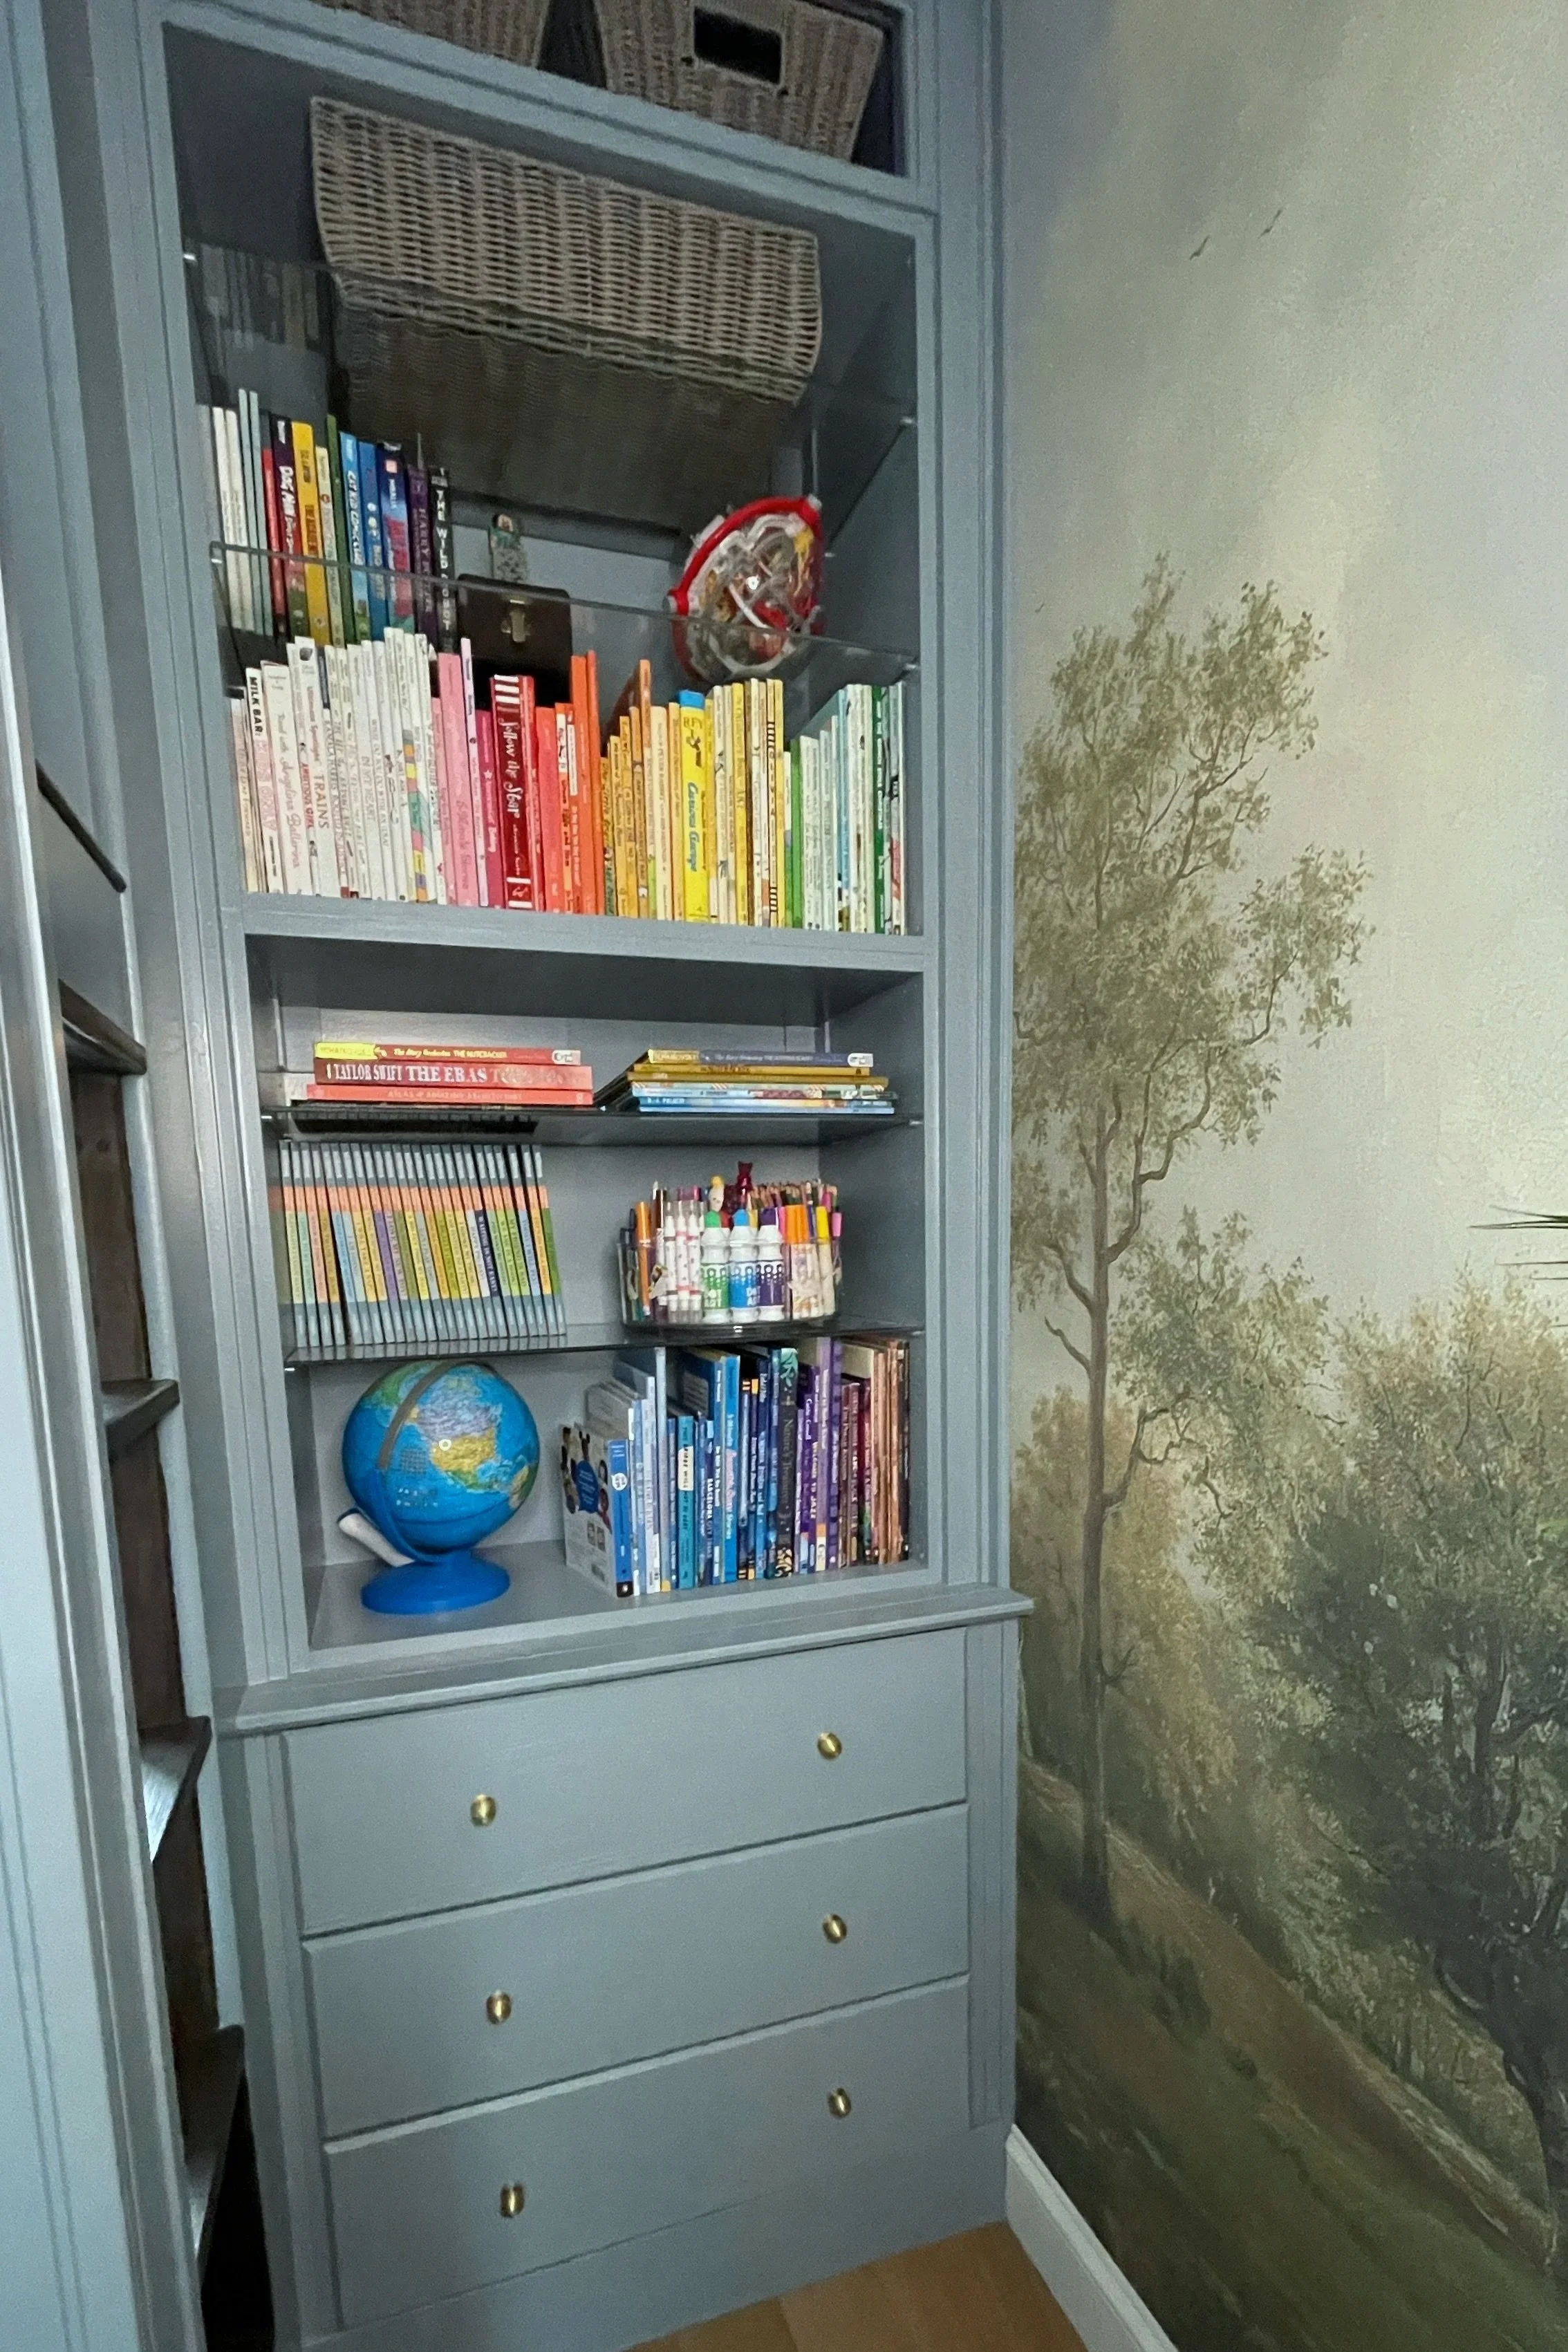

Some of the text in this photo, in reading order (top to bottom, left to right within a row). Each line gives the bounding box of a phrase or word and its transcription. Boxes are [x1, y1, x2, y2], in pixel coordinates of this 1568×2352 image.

[278, 464, 295, 490] DOG
[346, 469, 357, 489] CAT
[281, 489, 297, 517] MAN
[348, 489, 358, 508] KID
[436, 489, 446, 522] THE
[350, 510, 361, 541] COMIC
[416, 507, 430, 556] HARRY
[436, 526, 450, 569] WILD
[249, 676, 263, 736] MILK BAR:
[498, 717, 516, 756] Follow
[683, 717, 702, 729] REY
[309, 724, 320, 763] Spotlight
[277, 756, 297, 811] Angelina
[362, 767, 371, 786] MY
[506, 760, 518, 778] the
[301, 762, 315, 828] AMBITIOUS GIRL
[311, 774, 330, 830] TRAINS
[364, 787, 375, 821] HEART
[504, 781, 521, 818] Star
[736, 788, 745, 808] ART
[286, 812, 302, 868] Ballerina
[687, 783, 698, 871] Curious George
[453, 1049, 465, 1058] THE
[465, 1049, 507, 1058] NUTCRACKER
[333, 1063, 371, 1080] TAYLOR
[373, 1064, 402, 1081] SWIFT
[405, 1065, 440, 1081] THE
[442, 1066, 487, 1083] ERAS
[478, 1215, 489, 1246] WAITING
[485, 1256, 493, 1269] NOT
[488, 1271, 497, 1291] EASY!
[782, 1419, 793, 1457] Nature's
[706, 1478, 714, 1518] BARCELONA
[811, 1482, 816, 1492] TO
